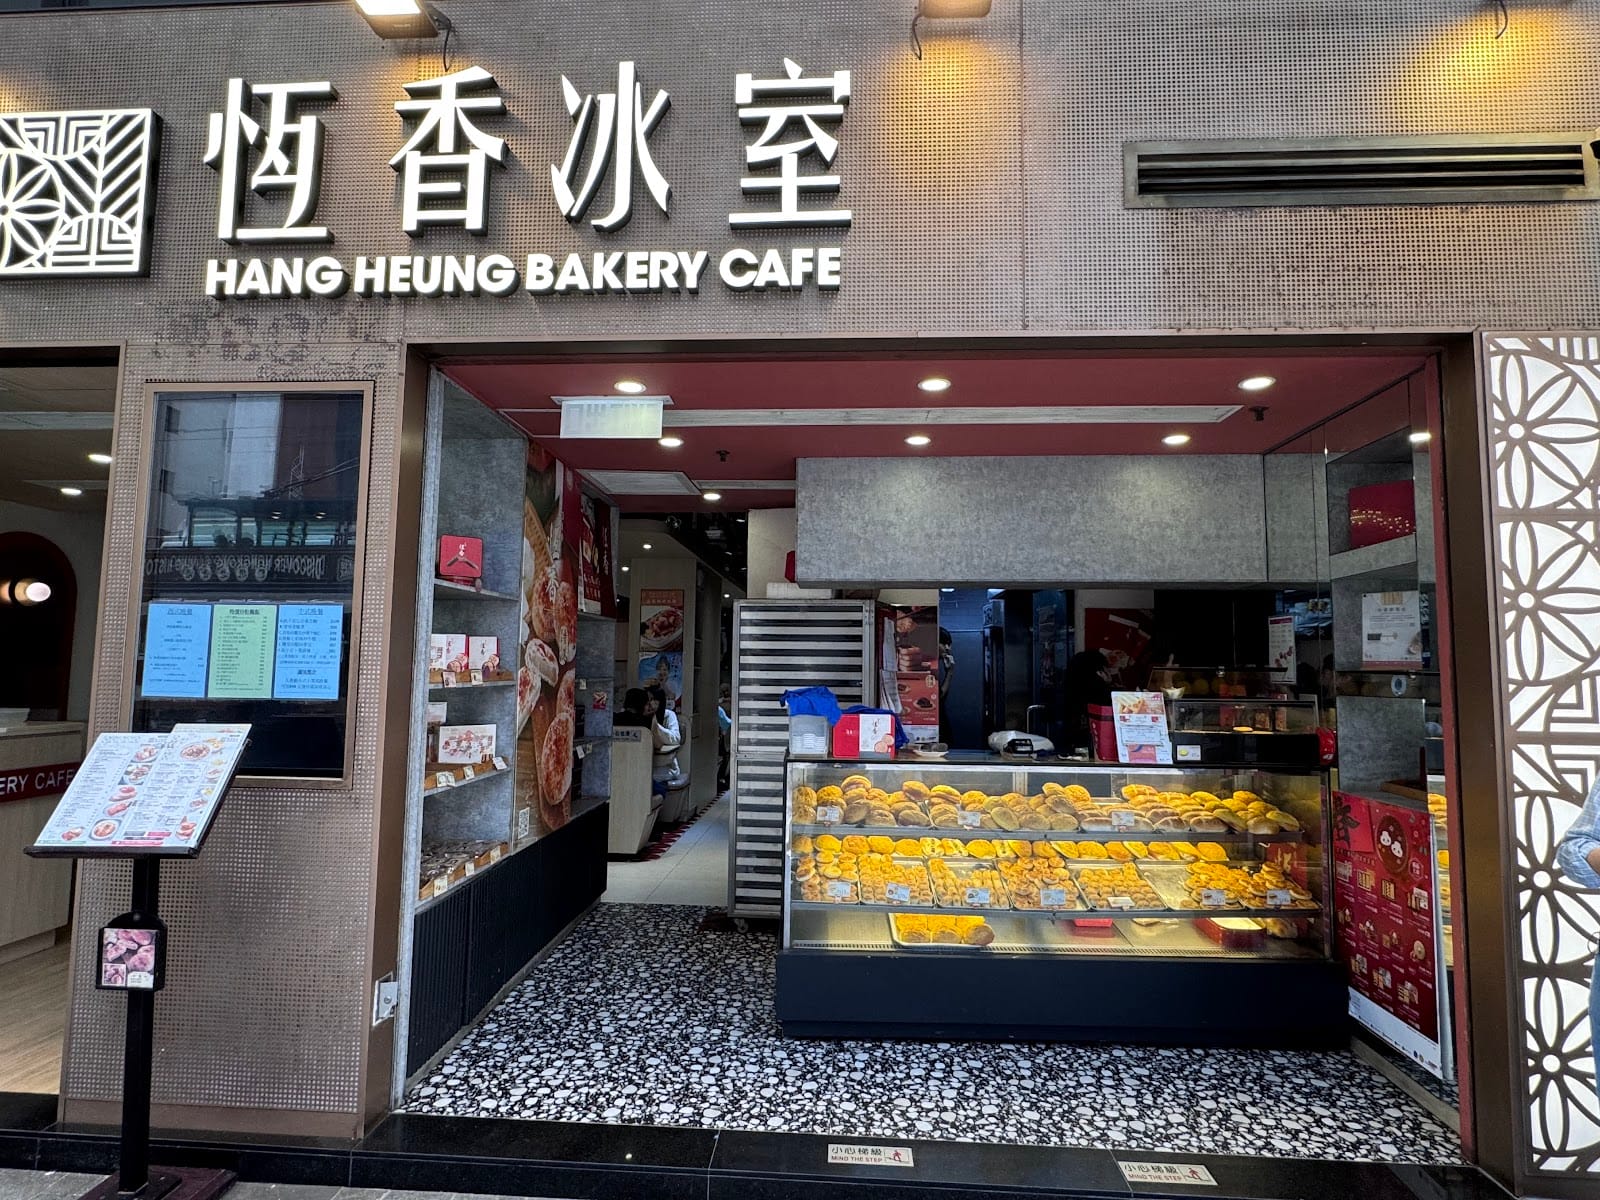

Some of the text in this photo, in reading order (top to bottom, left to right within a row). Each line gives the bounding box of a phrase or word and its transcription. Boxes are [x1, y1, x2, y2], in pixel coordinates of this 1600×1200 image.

[205, 247, 842, 297] HANG HEUNG BAKERY CAFE
[35, 769, 76, 790] CAFE
[831, 1147, 882, 1156] 小心梯級
[1124, 1164, 1179, 1174] 小心梯級
